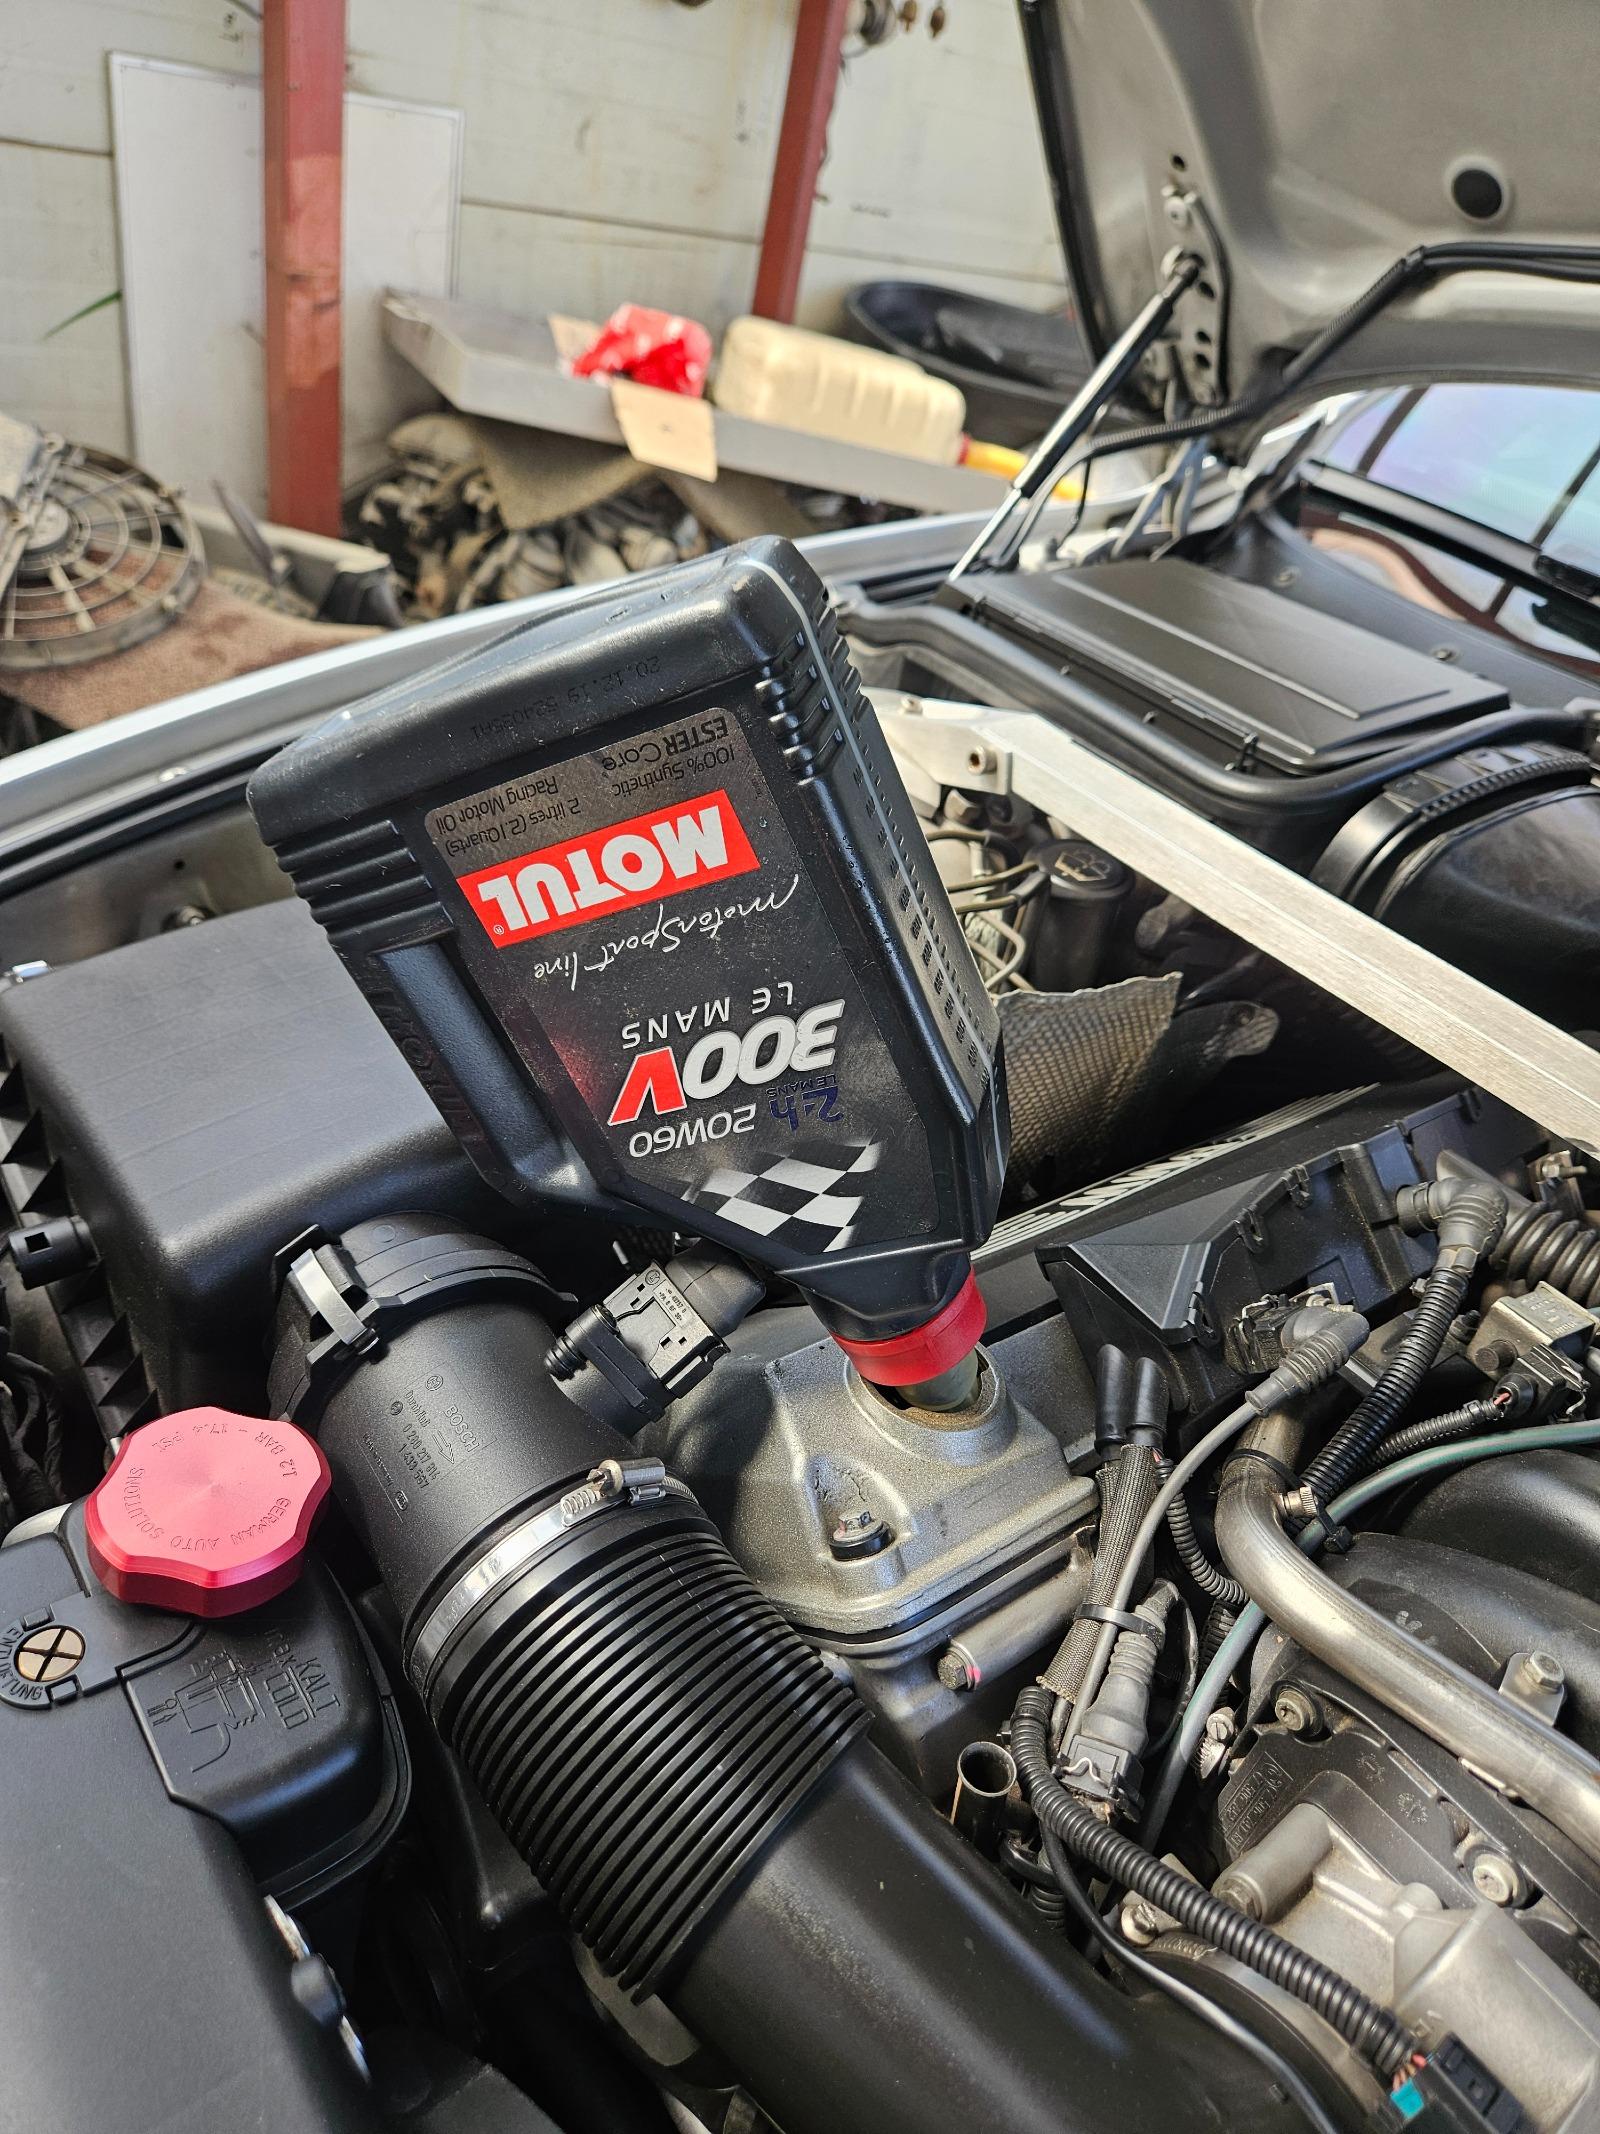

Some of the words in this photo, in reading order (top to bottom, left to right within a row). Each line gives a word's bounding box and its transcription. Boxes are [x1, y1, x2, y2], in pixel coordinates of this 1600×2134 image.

[662, 716, 729, 757] ESTER
[686, 744, 736, 772] 100%
[507, 775, 559, 804] Racing
[611, 760, 685, 797] Synthetic
[459, 795, 505, 823] Motor
[529, 801, 567, 824] litres
[568, 797, 582, 815] 2
[436, 814, 457, 836] Oil
[533, 951, 576, 991] line
[751, 981, 794, 1015] LE
[621, 996, 731, 1050] MANS
[607, 998, 846, 1127] 300V
[765, 1079, 814, 1099] MANS
[815, 1073, 838, 1088] LE
[628, 1103, 757, 1158] 20W60
[152, 1430, 185, 1453] PSI
[254, 1431, 287, 1455] BAR
[443, 1404, 480, 1453] BOSCH
[123, 1467, 165, 1540] SOLUTIONS
[230, 1497, 292, 1546] GERMAN
[169, 1535, 221, 1551] AUTO
[265, 1671, 310, 1730] COLD
[295, 1657, 341, 1712] KALT
